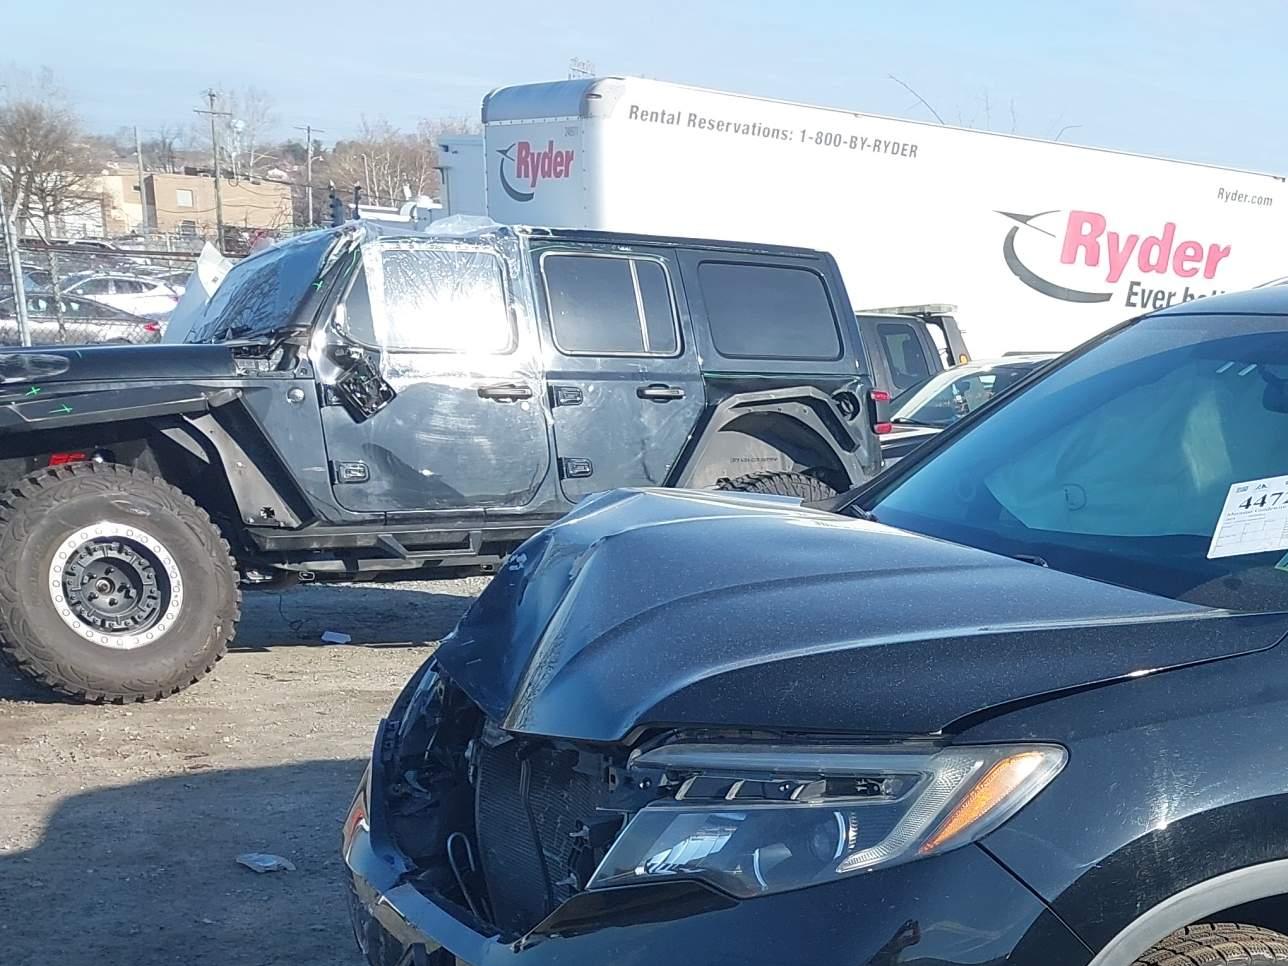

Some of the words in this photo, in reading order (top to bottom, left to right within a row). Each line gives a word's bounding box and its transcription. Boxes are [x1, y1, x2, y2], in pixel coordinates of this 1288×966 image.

[628, 104, 682, 125] Rental
[687, 112, 794, 142] Reservations:
[800, 129, 918, 158] 1-800-BY-RYDER
[516, 140, 574, 188] Ryder
[1217, 187, 1273, 206] Ryder.com
[1061, 210, 1232, 283] Ryder
[1125, 281, 1176, 309] Ever
